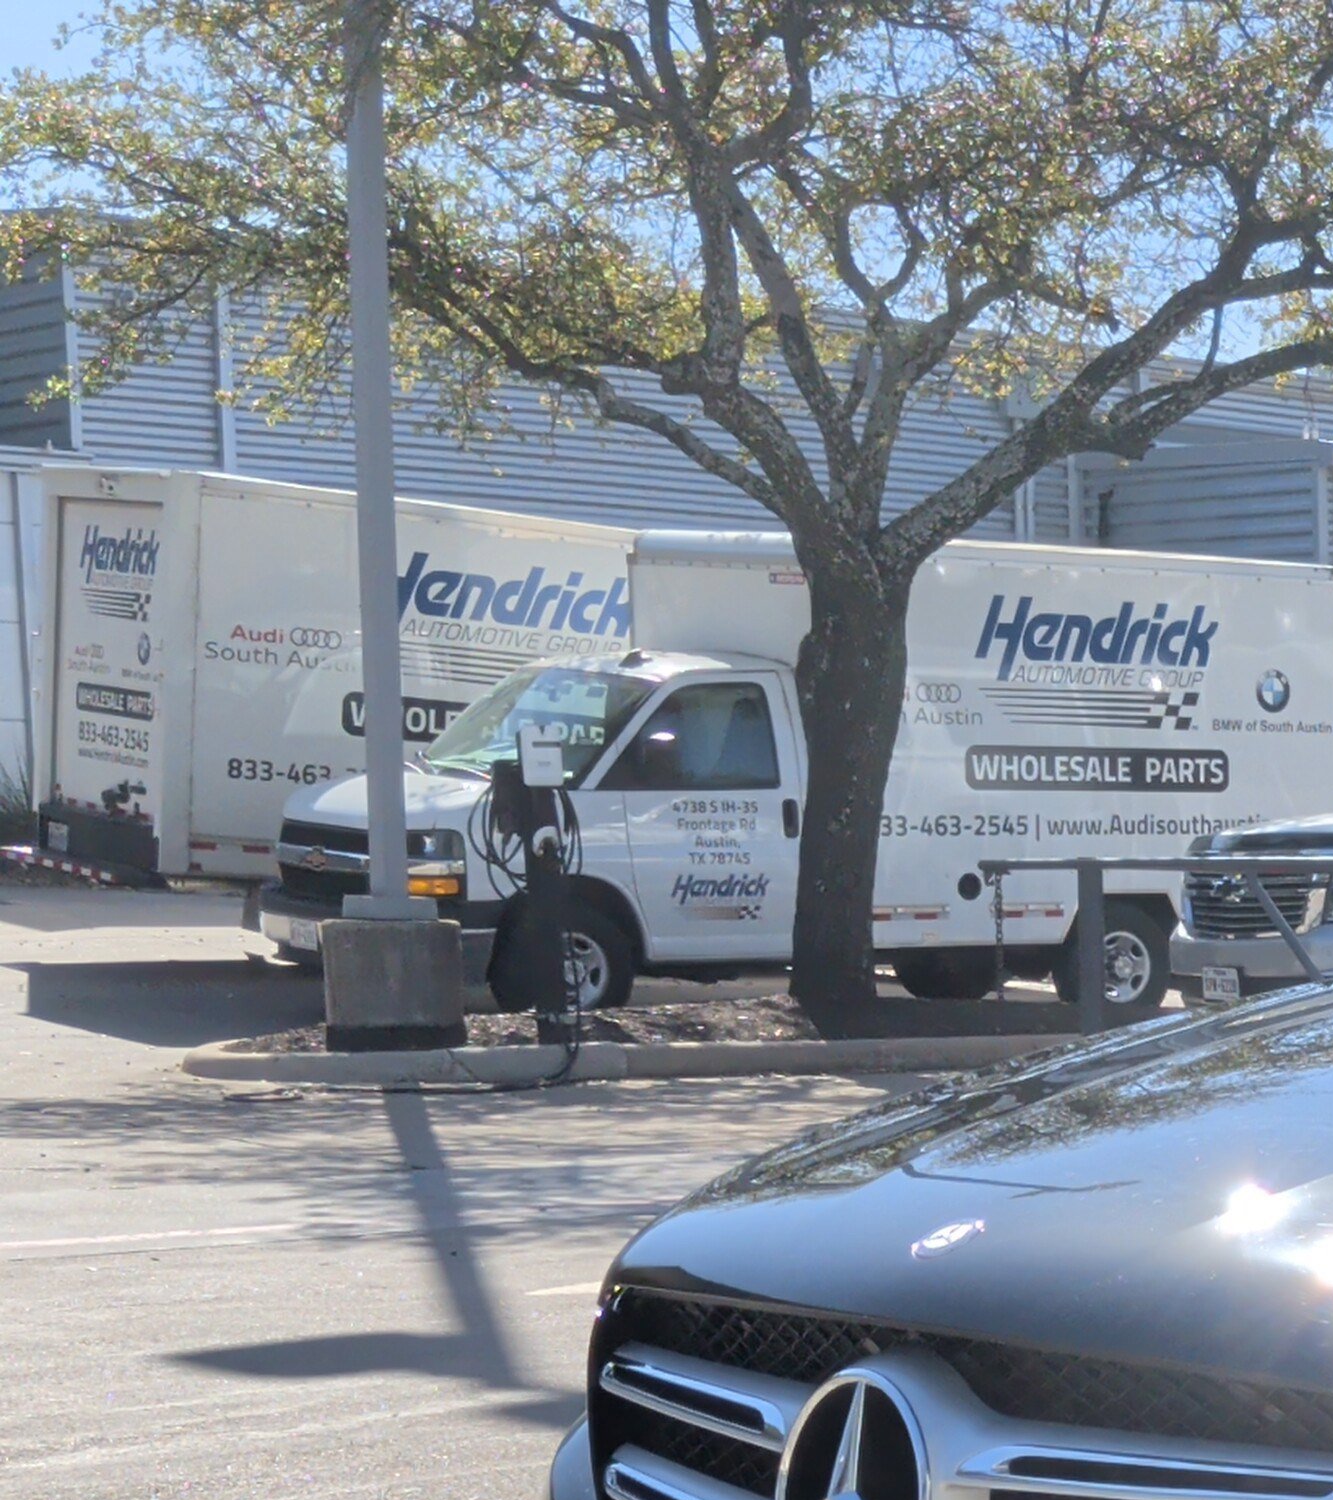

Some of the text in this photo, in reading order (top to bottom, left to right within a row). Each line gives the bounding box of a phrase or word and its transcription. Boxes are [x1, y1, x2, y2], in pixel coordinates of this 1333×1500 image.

[80, 525, 160, 584] Hendrick
[231, 625, 284, 643] Audi
[402, 618, 622, 655] AUTOMOTIVE GROUP
[975, 595, 1219, 681] Hendrick
[205, 641, 278, 666] South
[1013, 665, 1204, 689] AUTOMOTIVE GROUP
[78, 687, 126, 711] WHOLESALE
[914, 706, 984, 725] Austin
[1212, 719, 1242, 733] BMW
[1245, 719, 1257, 733] of
[1259, 720, 1294, 734] South
[1296, 721, 1333, 734] Austin
[78, 720, 150, 753] 833-463-2545
[971, 753, 1225, 785] WHOLESALE PARTS
[672, 801, 706, 813] 4738
[709, 801, 718, 813] S
[677, 818, 756, 833] Frontage Rd
[880, 815, 1028, 837] 33-463-2545
[689, 852, 751, 865] TX 78745
[671, 873, 770, 905] Hendrick
